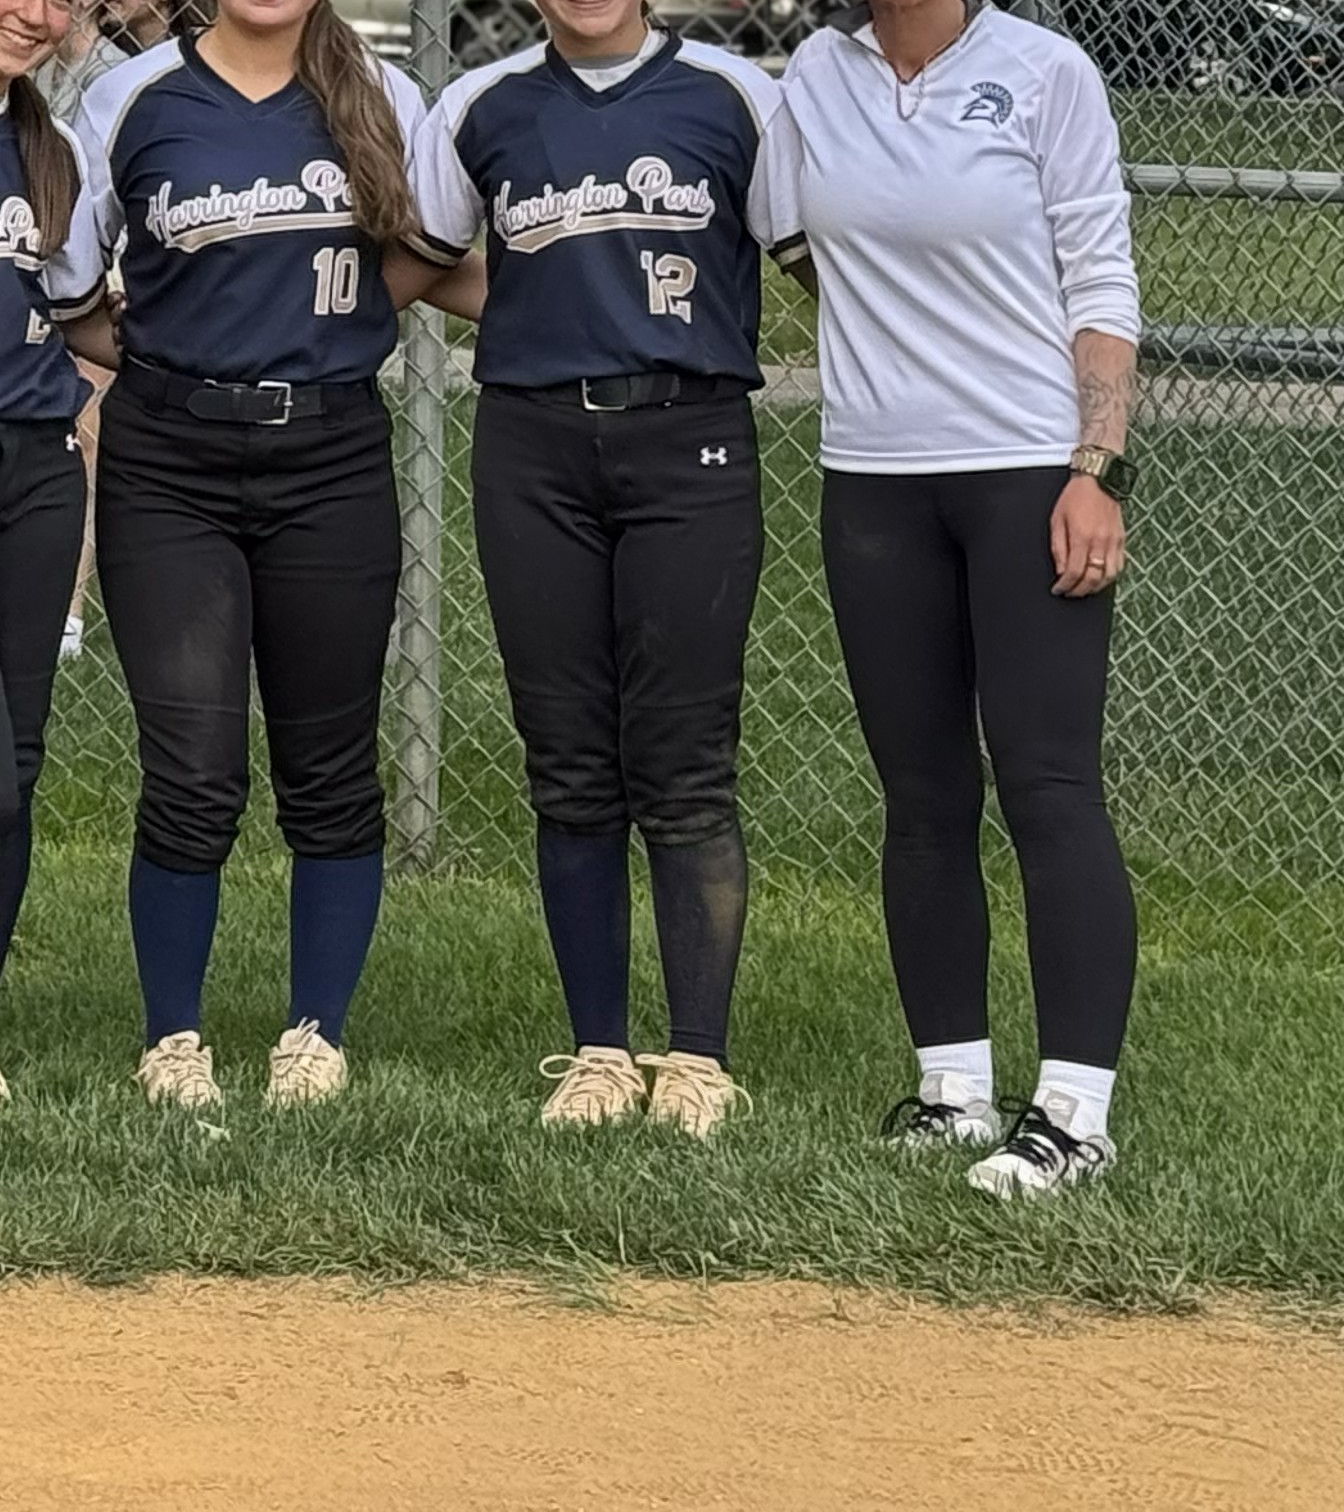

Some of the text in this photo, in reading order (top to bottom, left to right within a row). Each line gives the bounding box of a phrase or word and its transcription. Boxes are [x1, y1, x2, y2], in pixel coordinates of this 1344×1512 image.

[145, 176, 306, 243] Harrington
[494, 156, 715, 242] Harrington Park
[313, 247, 360, 316] 10
[640, 250, 698, 324] 12
